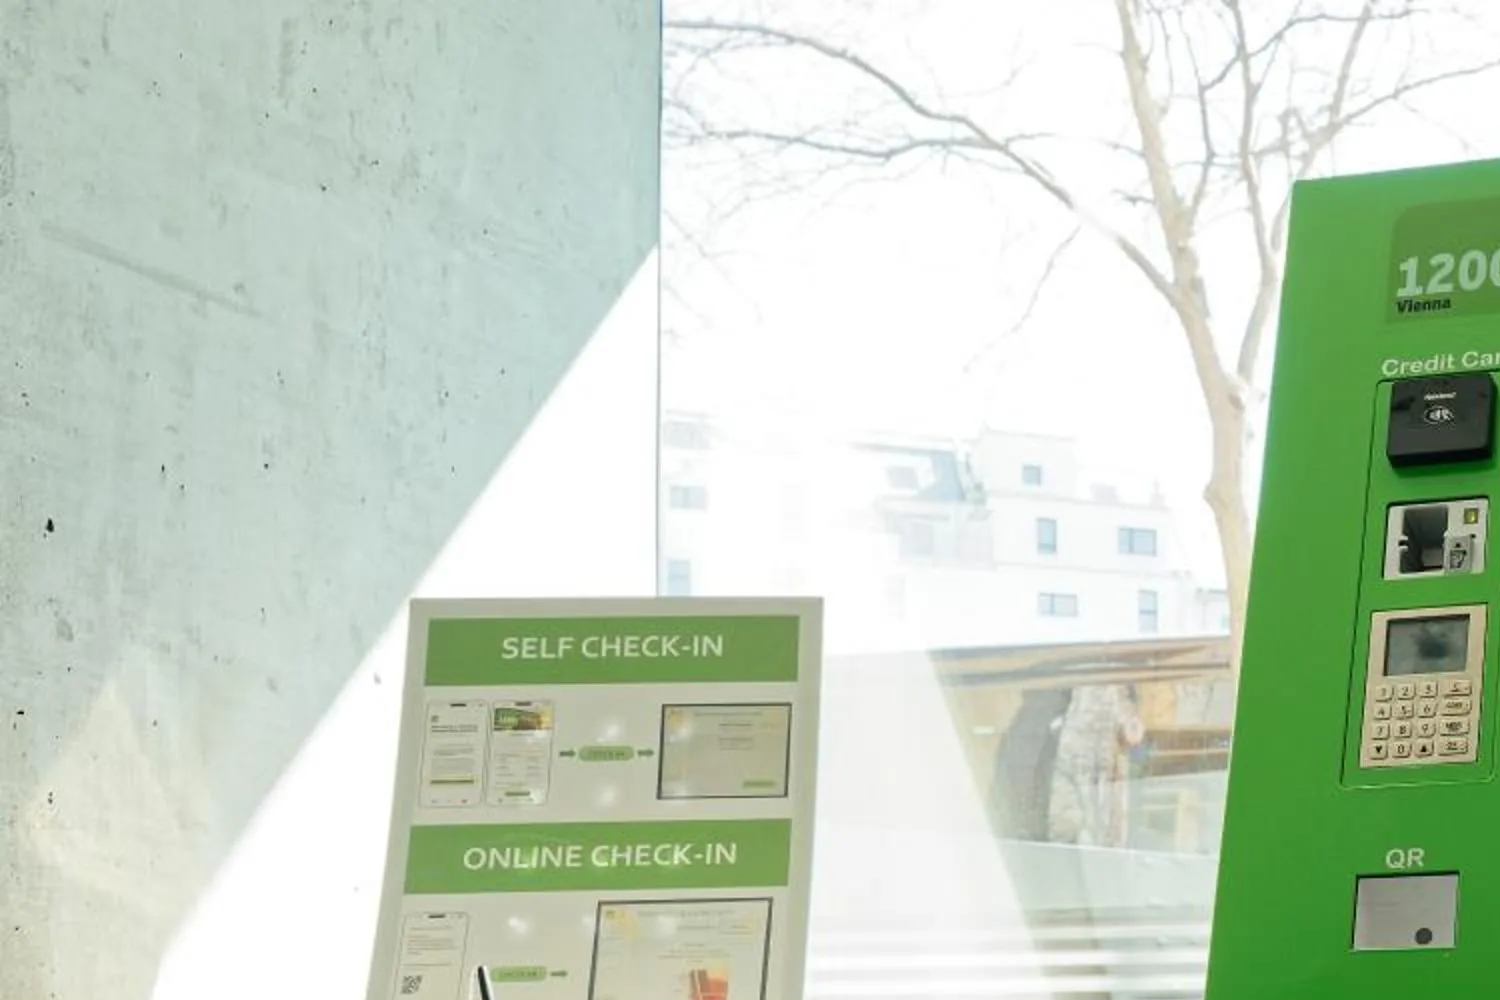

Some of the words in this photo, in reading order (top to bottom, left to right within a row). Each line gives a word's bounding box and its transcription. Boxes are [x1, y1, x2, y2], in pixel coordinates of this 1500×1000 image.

[1397, 296, 1452, 314] Vienna
[1381, 352, 1455, 377] Credit
[501, 636, 575, 660] SELF
[581, 634, 724, 659] CHECK-IN
[462, 845, 582, 870] ONLINE
[590, 842, 738, 868] CHECK-IN
[1385, 847, 1425, 869] QR
